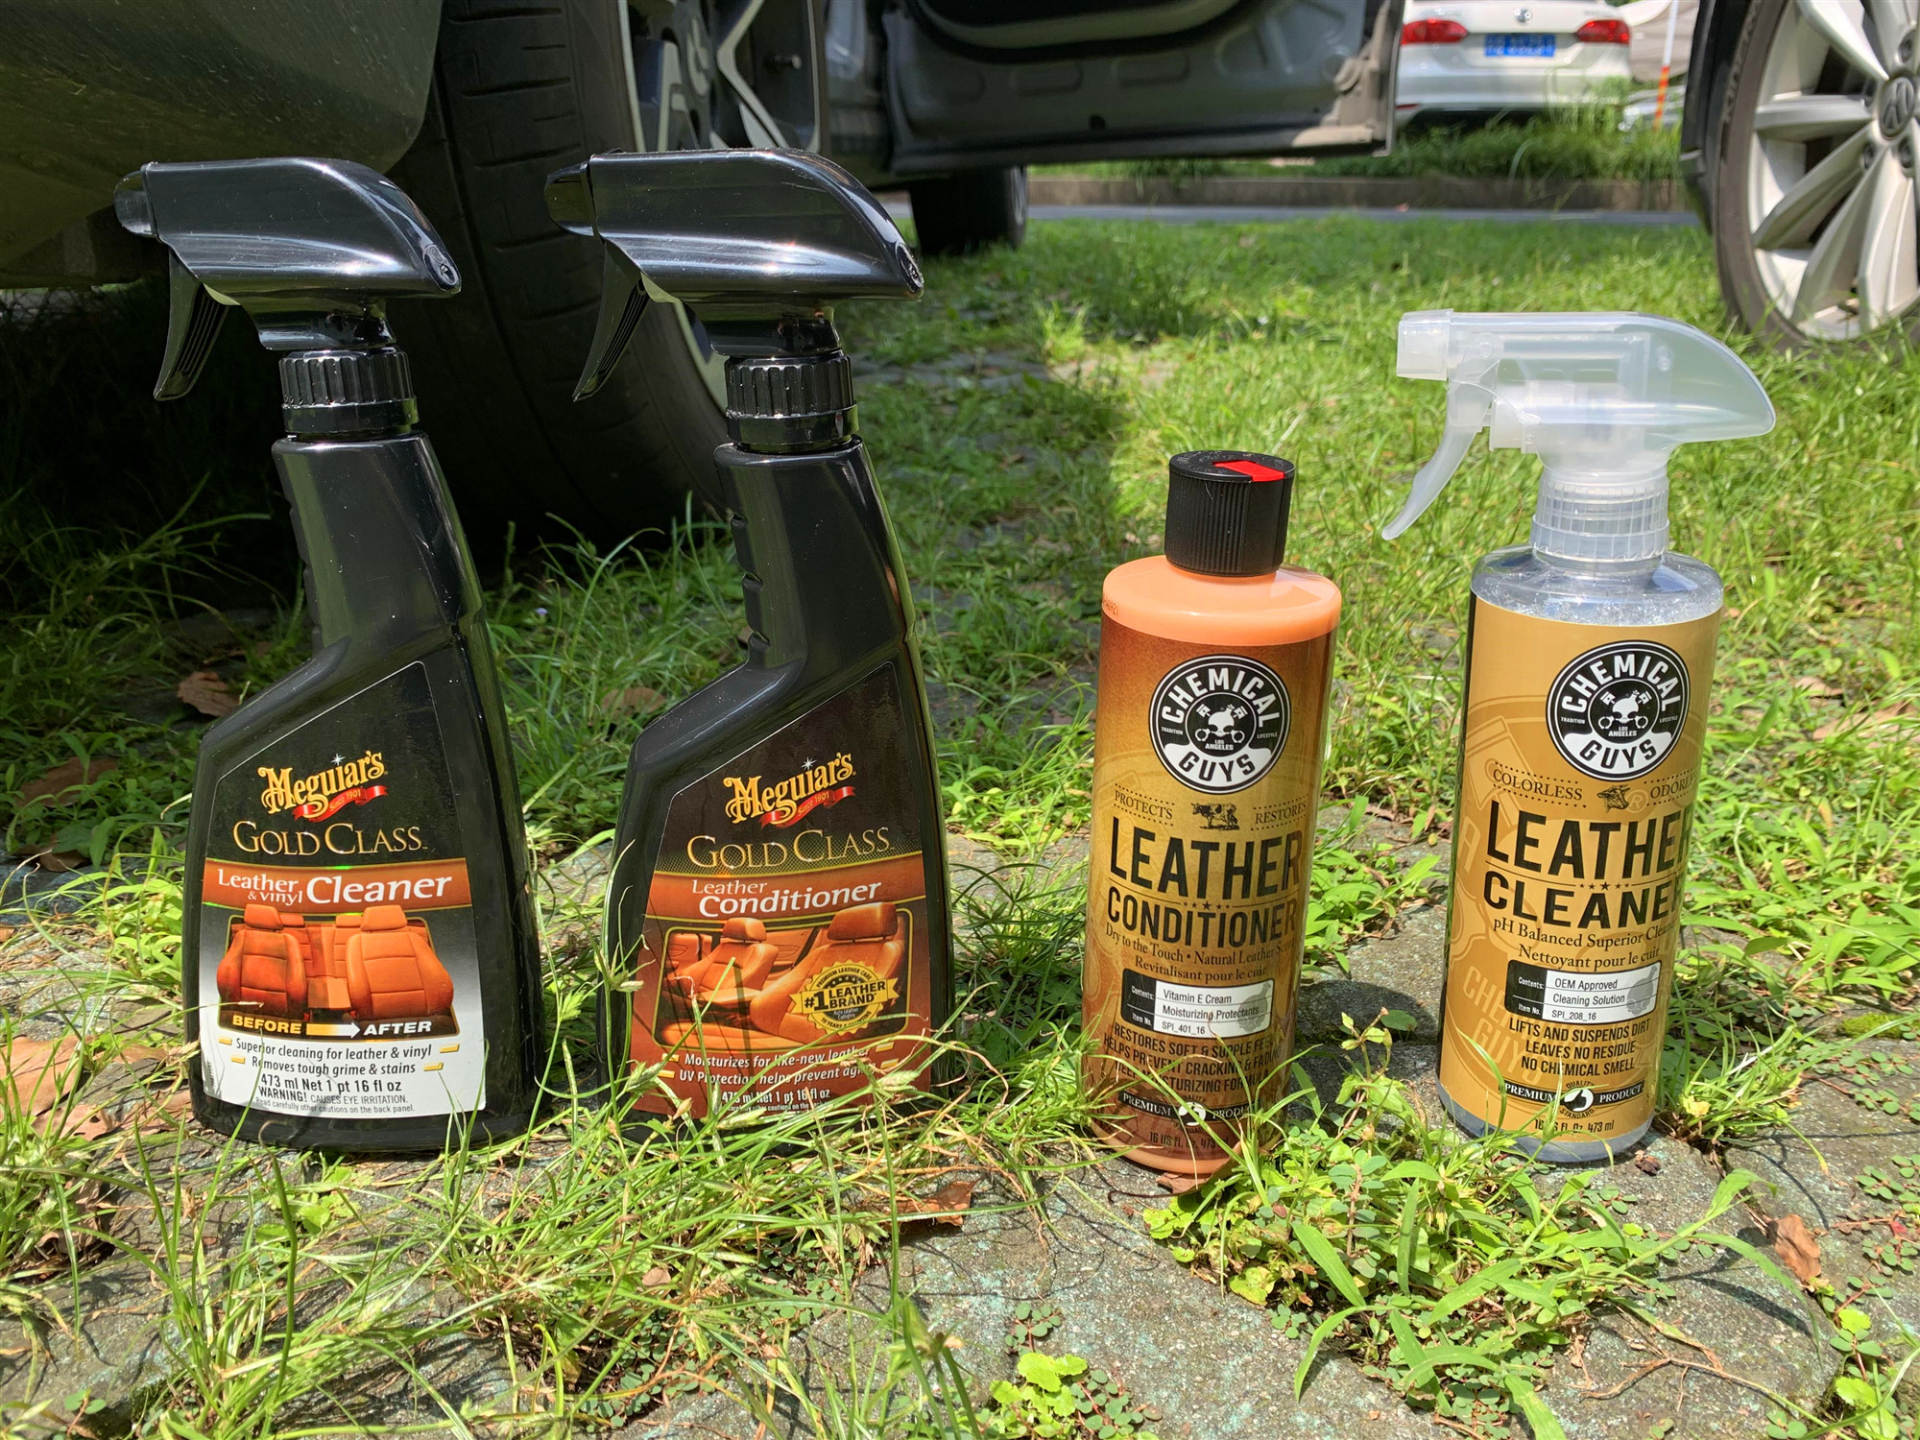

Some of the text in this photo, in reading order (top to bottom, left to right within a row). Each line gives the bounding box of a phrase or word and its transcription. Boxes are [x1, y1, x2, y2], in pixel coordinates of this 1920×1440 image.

[1561, 653, 1681, 713] CHEMICAL
[1161, 667, 1281, 728] CHEMICAL
[1178, 750, 1255, 782] GUYS
[1579, 738, 1657, 769] GUYS
[257, 750, 385, 819] Meguiar's
[723, 752, 854, 824] Meguiar's
[1493, 769, 1583, 801] COLORLESS
[1114, 790, 1173, 820] PROTECTS
[232, 821, 422, 856] GOLD CLASS
[687, 827, 890, 869] GOLD CLASS
[1110, 816, 1303, 900] LEATHER
[218, 868, 298, 893] Leather
[306, 875, 453, 903] Cleaner
[692, 880, 767, 895] Leather
[248, 889, 303, 905] & vinyl
[699, 882, 882, 918] Conditioner
[1107, 886, 1297, 948] CONDITIONER
[1106, 922, 1121, 942] Dry
[1122, 934, 1131, 946] to
[1133, 938, 1148, 954] the
[1150, 943, 1184, 962] Touch
[1194, 951, 1236, 966] Natural
[1493, 918, 1643, 951] pH Balanced Superior
[1135, 955, 1202, 980] Revitalisant
[1205, 971, 1233, 984] pour
[1235, 968, 1245, 980] le
[1518, 943, 1660, 972] Nettoyant pour le cuir
[804, 981, 886, 1011] #1 LEATHER
[1163, 988, 1195, 1003] Vitamin
[1197, 994, 1203, 1003] E
[1205, 994, 1232, 1004] Cream
[1554, 977, 1576, 988] OEM
[1578, 979, 1618, 991] Approved
[828, 993, 875, 1009] BRAND
[1552, 993, 1625, 1007] Cleaning Solution
[232, 1015, 432, 1036] BEFORE AFTER
[1162, 1005, 1260, 1021] Moisturizing Protectants
[1114, 1022, 1166, 1053] RESTORES
[1168, 1042, 1196, 1057] SOFT
[1509, 1017, 1650, 1043] LIFTS AND SUSPENDS DIRT
[279, 1045, 323, 1061] cleaning
[327, 1048, 342, 1060] for
[345, 1048, 388, 1060] leather
[390, 1047, 400, 1058] &
[403, 1044, 432, 1060] vinyl
[1104, 1033, 1131, 1058] HELPS
[1525, 1039, 1636, 1060] LEAVES NO RESIDUE
[298, 1063, 329, 1078] tough
[333, 1065, 365, 1077] grime
[369, 1064, 377, 1075] &
[380, 1063, 416, 1074] stains
[753, 1055, 771, 1069] for
[1521, 1056, 1538, 1071] NO
[1603, 1057, 1635, 1075] SMELL
[261, 1073, 402, 1095] 473 ml Net 1 pt 16 fl oz
[680, 1069, 695, 1082] UV
[698, 1071, 754, 1085] Protectio
[794, 1068, 840, 1085] prevent
[1142, 1069, 1220, 1093] STURIZING
[258, 1085, 307, 1102] WARNING!
[311, 1095, 341, 1105] CAUSES
[343, 1096, 359, 1104] EYE
[784, 1090, 794, 1104] pt
[820, 1089, 830, 1099] oz
[1123, 1092, 1171, 1117] PREMIUM
[1600, 1083, 1643, 1103] PRODUCT
[1587, 1120, 1603, 1132] 473
[1604, 1120, 1615, 1131] ml
